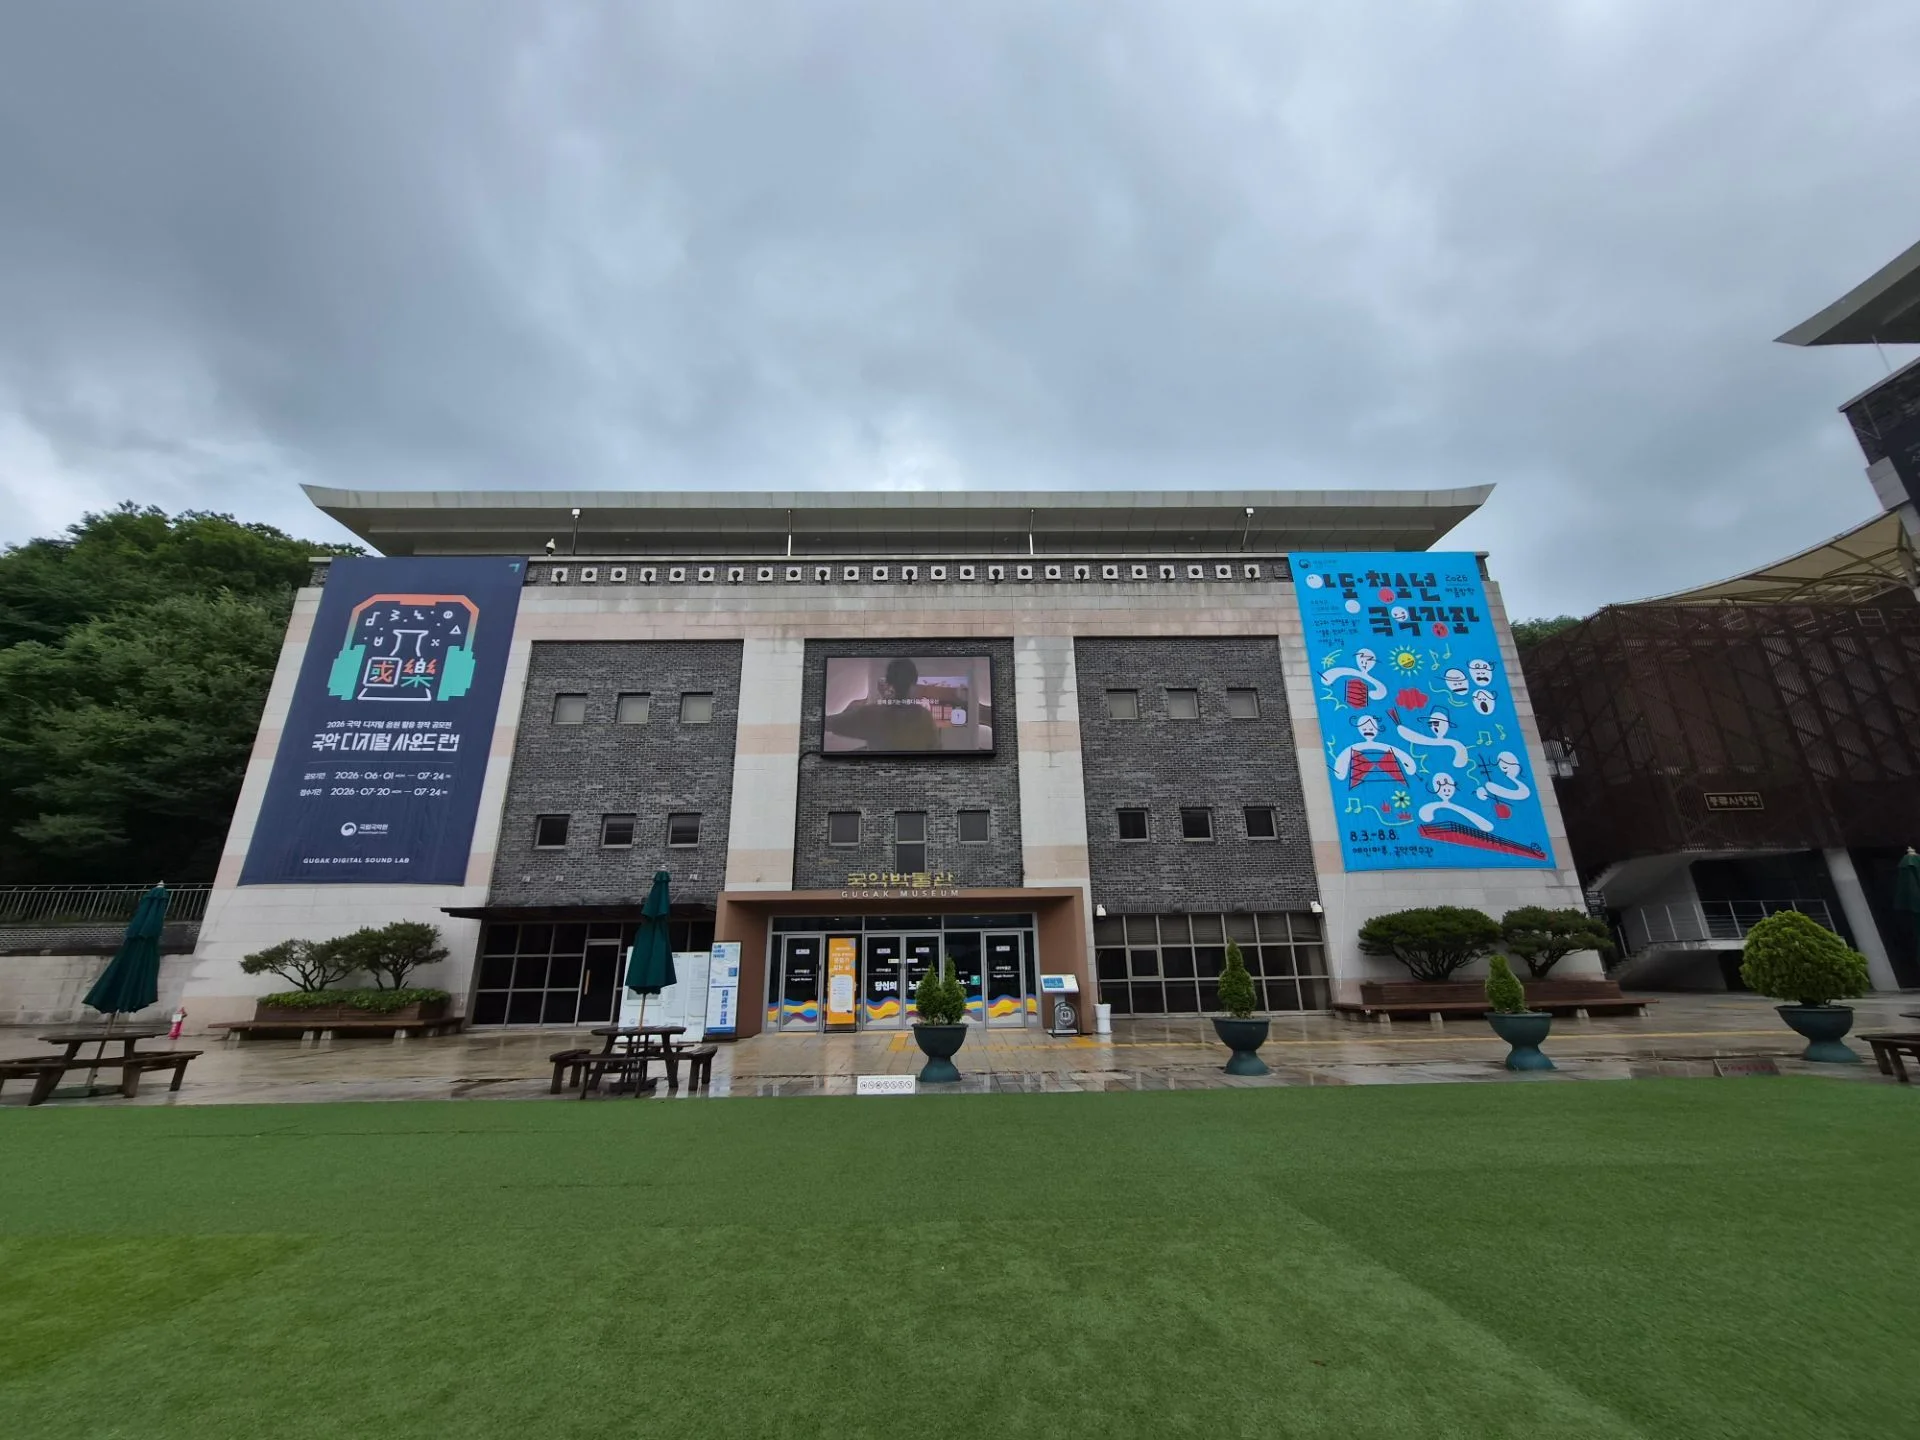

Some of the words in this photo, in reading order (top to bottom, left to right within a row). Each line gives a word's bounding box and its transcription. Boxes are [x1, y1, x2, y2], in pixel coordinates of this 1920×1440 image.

[1445, 574, 1468, 582] 2026
[326, 720, 345, 729] 2026
[346, 720, 361, 728] 국악
[362, 721, 385, 729] 디지털
[312, 733, 340, 751] 국악
[340, 732, 392, 751] 디지털
[392, 733, 438, 751] 사운드
[437, 733, 460, 752] 랩
[848, 872, 954, 888] 국악박물관
[842, 890, 889, 898] GUGAK
[874, 981, 897, 991] 당신의
